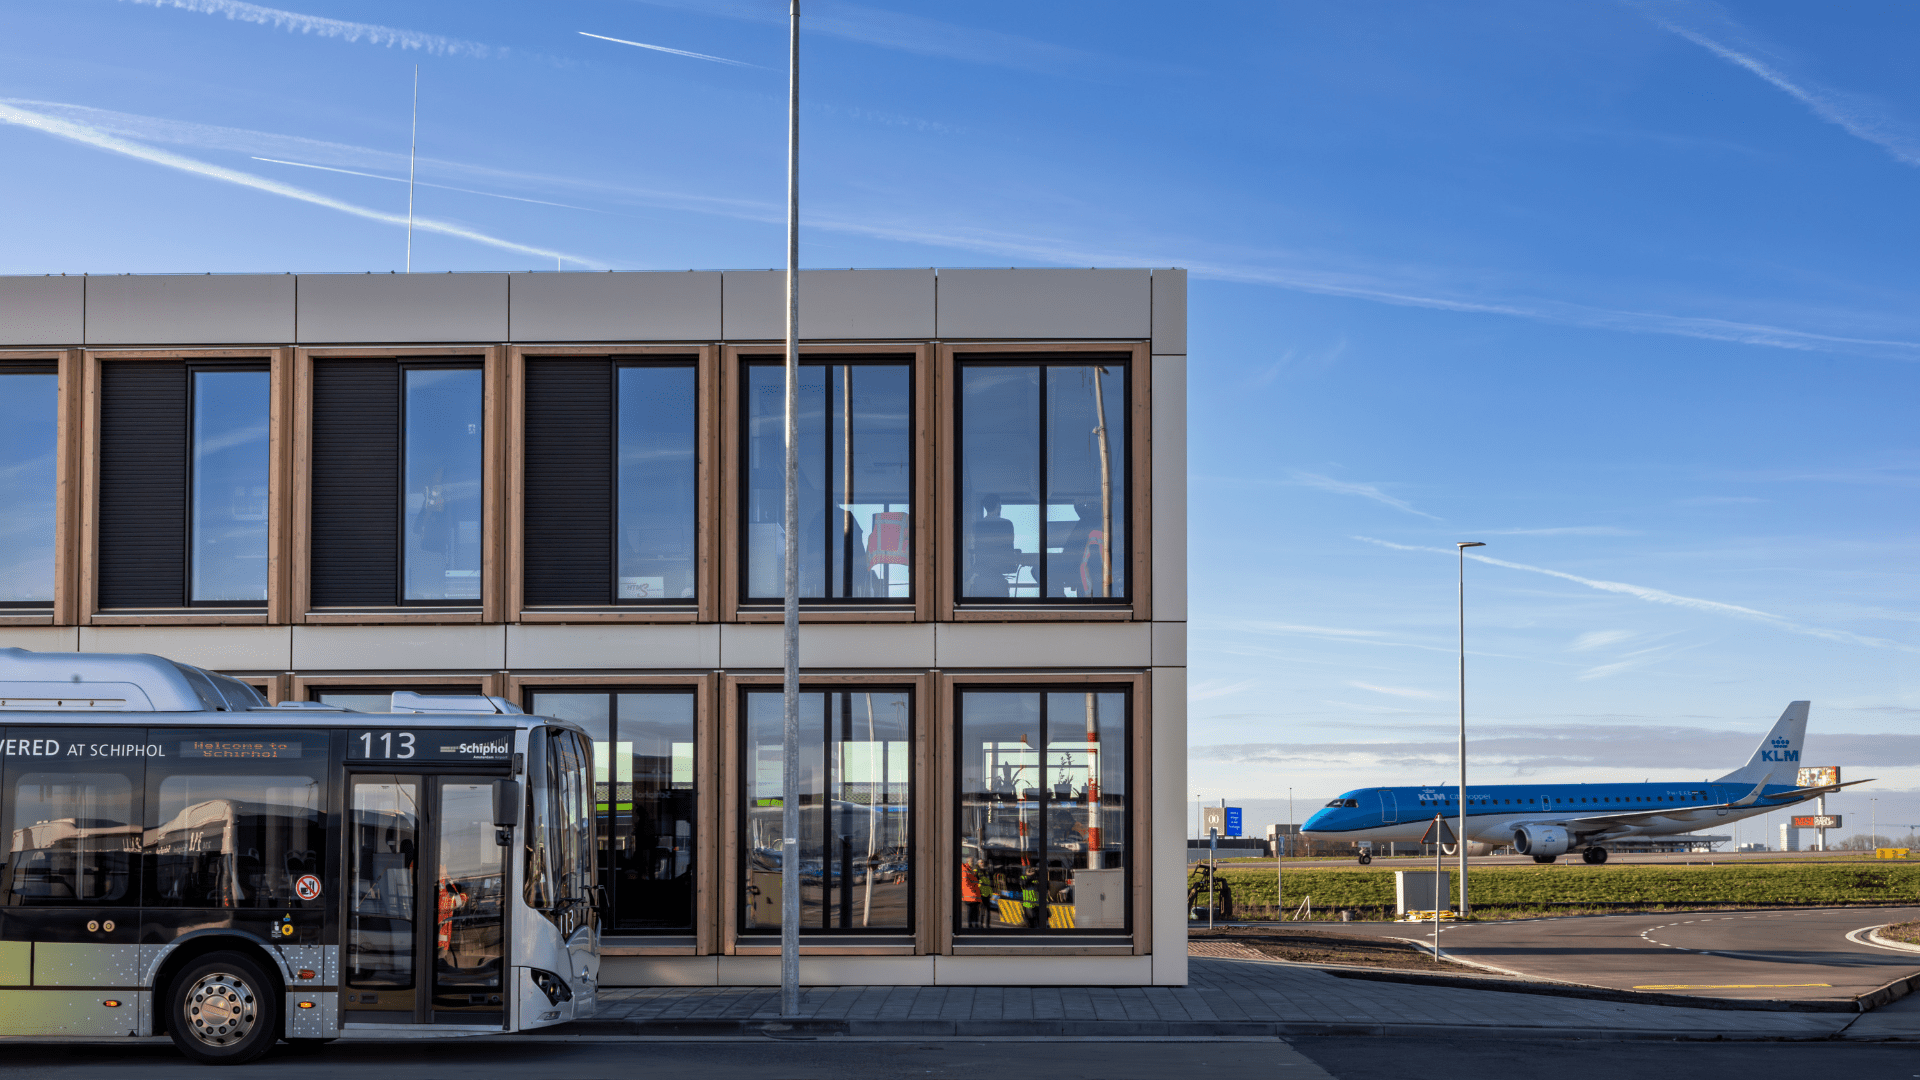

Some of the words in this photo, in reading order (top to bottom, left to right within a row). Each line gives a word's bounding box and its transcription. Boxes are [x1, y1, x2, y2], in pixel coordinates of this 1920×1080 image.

[67, 744, 86, 756] AT
[90, 744, 166, 757] SCHIPHOL
[194, 741, 263, 750] Welcome
[269, 742, 288, 750] to
[360, 732, 416, 759] 113
[459, 743, 509, 756] Schiphol
[1761, 750, 1799, 762] KLM
[1418, 793, 1446, 801] KLM
[560, 909, 574, 935] 113
